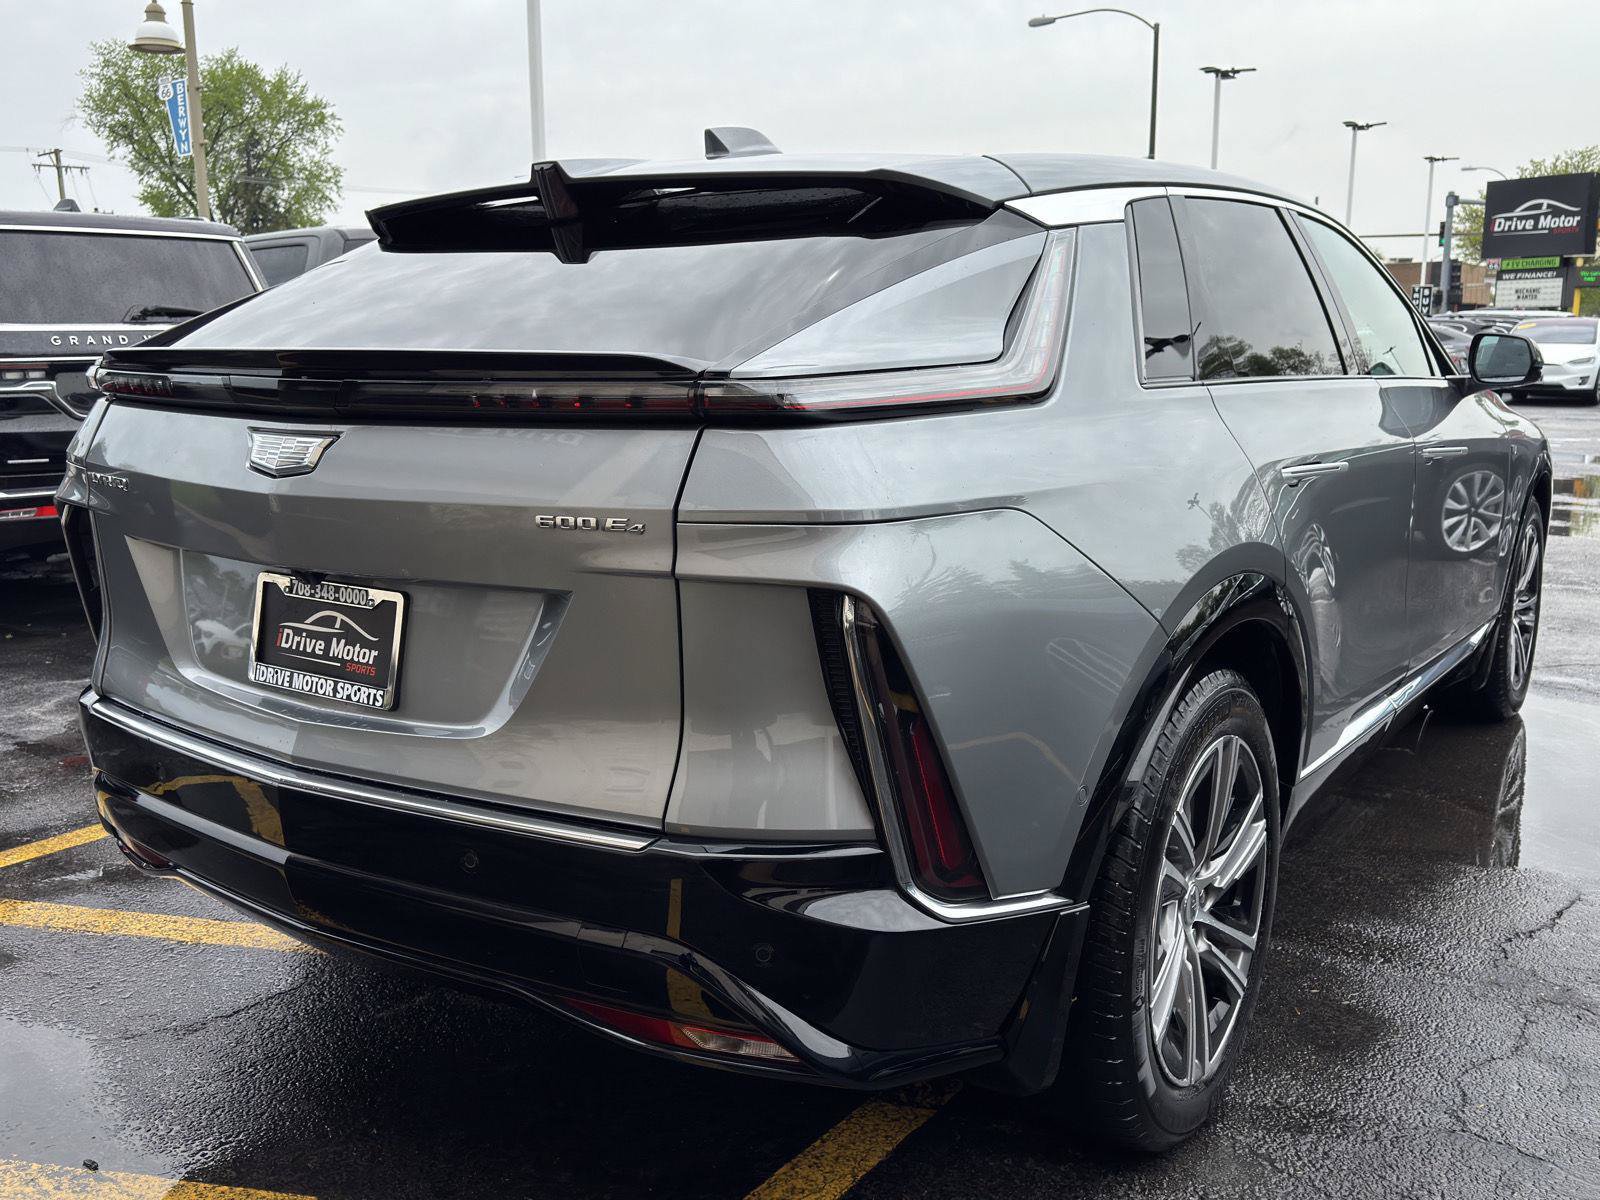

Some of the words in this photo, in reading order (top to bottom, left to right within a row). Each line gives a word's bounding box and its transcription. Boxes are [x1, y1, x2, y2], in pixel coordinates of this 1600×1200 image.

[162, 88, 171, 98] 66
[176, 82, 188, 153] BERWYN
[1538, 214, 1581, 229] Motor
[1522, 257, 1557, 267] CHARGING
[1516, 271, 1557, 279] FINANCE!
[1422, 288, 1430, 314] SUV
[50, 335, 129, 345] GRAND
[535, 515, 598, 530] 600
[602, 517, 647, 535] E4
[291, 580, 368, 605] 708-348-0000
[276, 629, 325, 654] iDrive
[329, 637, 379, 665] Motor
[345, 662, 377, 677] SPORTS
[292, 672, 334, 697] MOTOR
[337, 682, 384, 707] SPORTS
